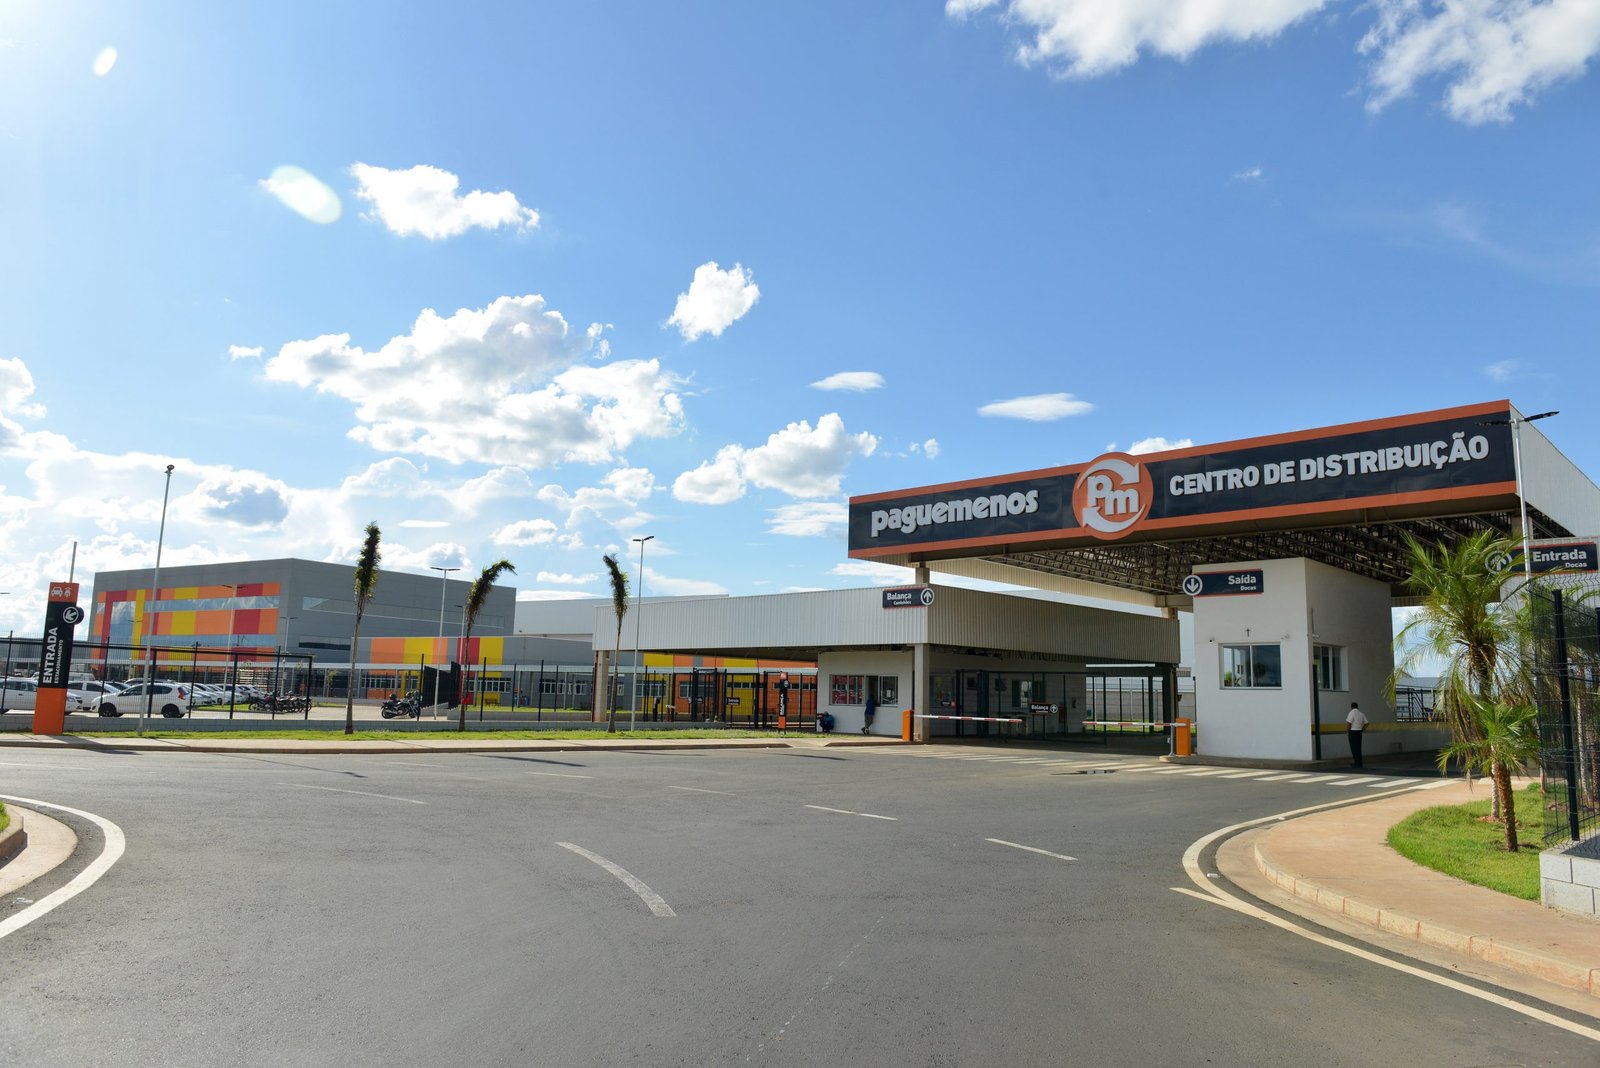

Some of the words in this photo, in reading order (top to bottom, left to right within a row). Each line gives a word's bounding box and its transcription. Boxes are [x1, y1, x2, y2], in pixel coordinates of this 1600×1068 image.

[1169, 464, 1261, 496] CENTRO
[1263, 461, 1296, 485] DE
[1299, 431, 1490, 481] DISTRIBUIÇÃO
[871, 489, 1040, 538] paguemenos
[1533, 549, 1587, 562] Entrada
[886, 592, 912, 601] Balança
[1228, 574, 1257, 585] Saída
[43, 627, 59, 684] ENTRADA
[54, 640, 64, 684] ESTACIONAMENTO
